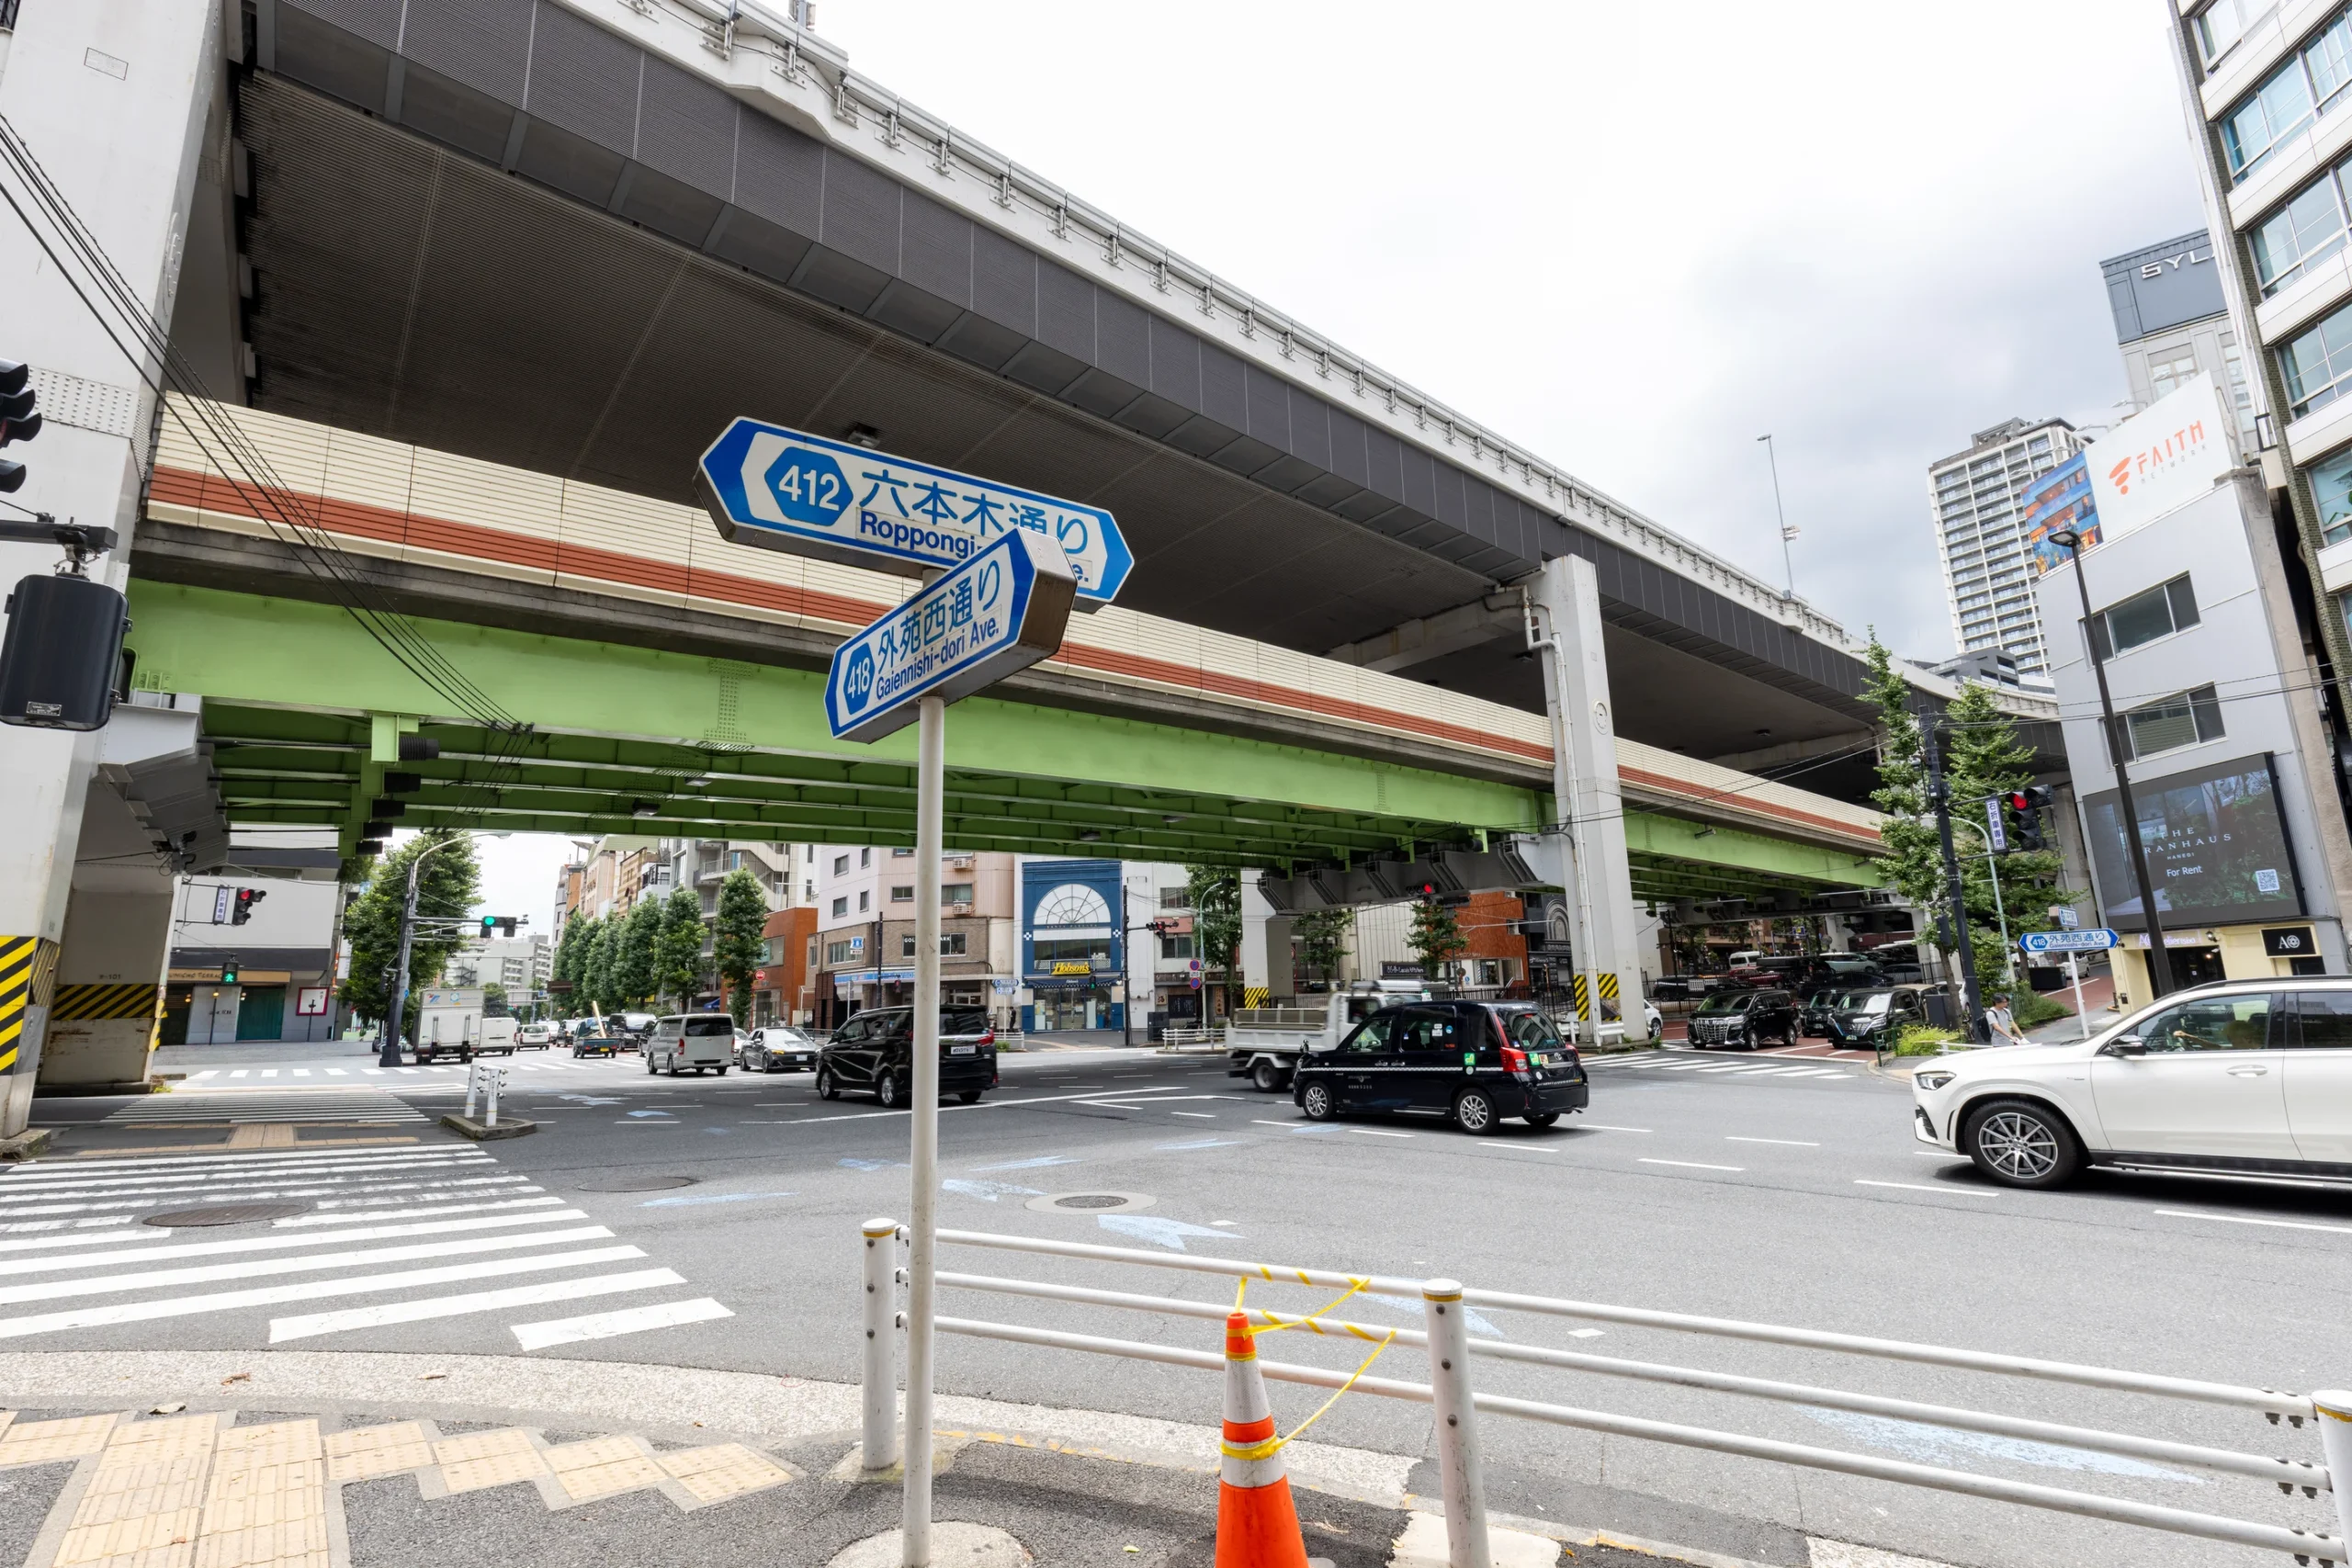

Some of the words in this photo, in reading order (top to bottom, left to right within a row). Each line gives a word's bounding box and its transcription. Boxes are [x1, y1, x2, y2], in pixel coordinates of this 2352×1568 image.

[2141, 251, 2215, 279] SYL
[2136, 419, 2204, 475] FAITH
[778, 465, 840, 512] 412
[859, 469, 1088, 555] 六本木通り
[860, 510, 984, 561] Roppongi-
[877, 560, 1001, 674] 外苑西通り
[876, 628, 966, 701] Gaiennishi-dori
[969, 616, 1000, 649] Ave.
[847, 657, 871, 699] 418
[2144, 833, 2232, 854] RANHAUS
[2160, 827, 2195, 840] THE
[2166, 868, 2179, 877] For
[2182, 865, 2203, 875] Rent
[2032, 938, 2046, 946] 418
[2049, 932, 2105, 943] 外苑西通り
[1052, 961, 1091, 975] Hobson's
